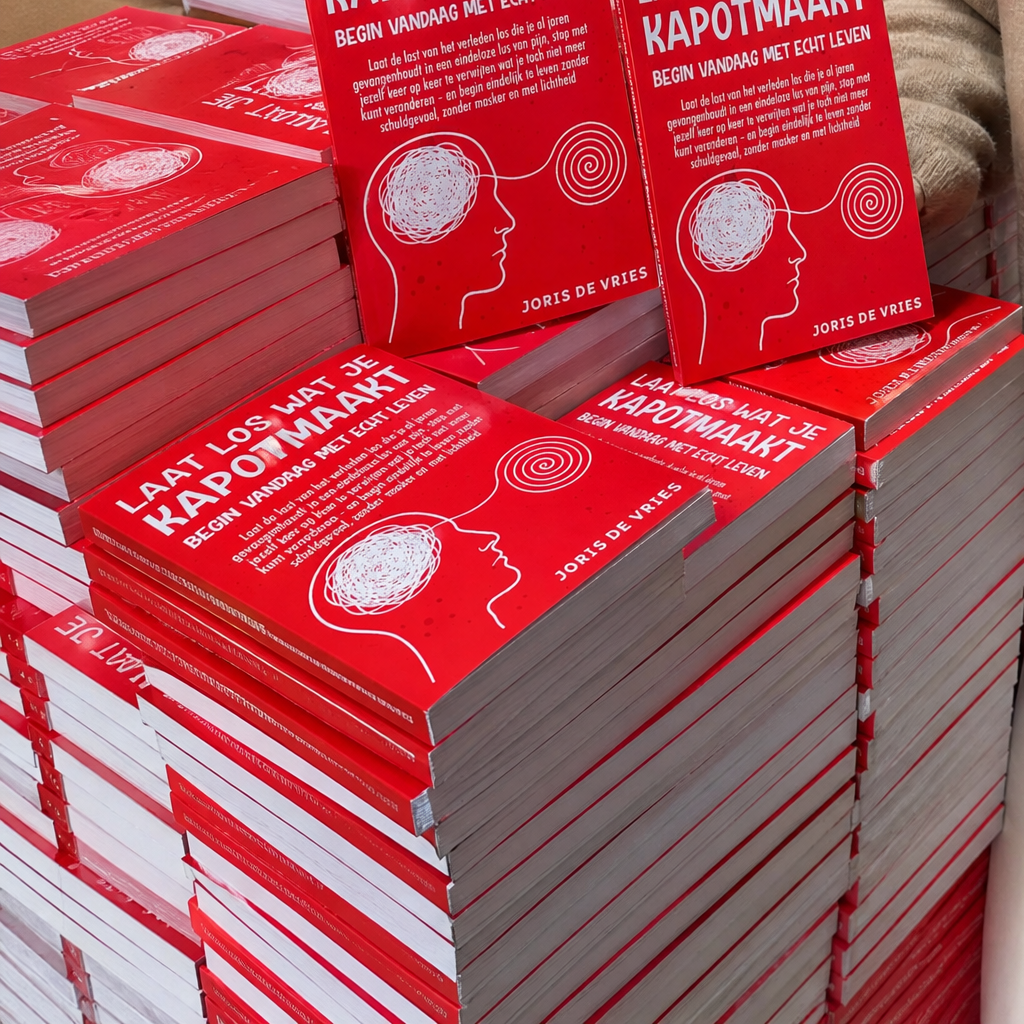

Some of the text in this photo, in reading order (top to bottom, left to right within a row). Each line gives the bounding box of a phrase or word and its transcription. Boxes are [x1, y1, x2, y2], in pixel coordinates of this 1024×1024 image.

[335, 21, 383, 48] BEGIN
[387, 4, 458, 35] VANDAAG
[652, 24, 871, 88] BEGIN VANDAAG MET ECHT LEVEN
[522, 266, 647, 313] JORIS DE VRIES
[813, 297, 922, 337] JORIS DE VRIES
[115, 355, 379, 514] LAAT LOS WAT JE
[598, 389, 806, 462] KAPOTMAAKT
[732, 403, 791, 427] WAT
[788, 422, 827, 441] JE
[142, 365, 410, 536] KAPOTMAAKT
[183, 507, 242, 549] BEGIN
[239, 458, 316, 508] VANDAAG
[314, 434, 351, 460] MET
[348, 411, 389, 438] ECHT
[385, 384, 436, 414] LEVEN
[668, 440, 698, 454] MET
[691, 449, 729, 465] ECHT
[723, 459, 771, 480] LEVEN
[555, 482, 682, 581] JORIS DE VRIES
[53, 615, 103, 646] JE
